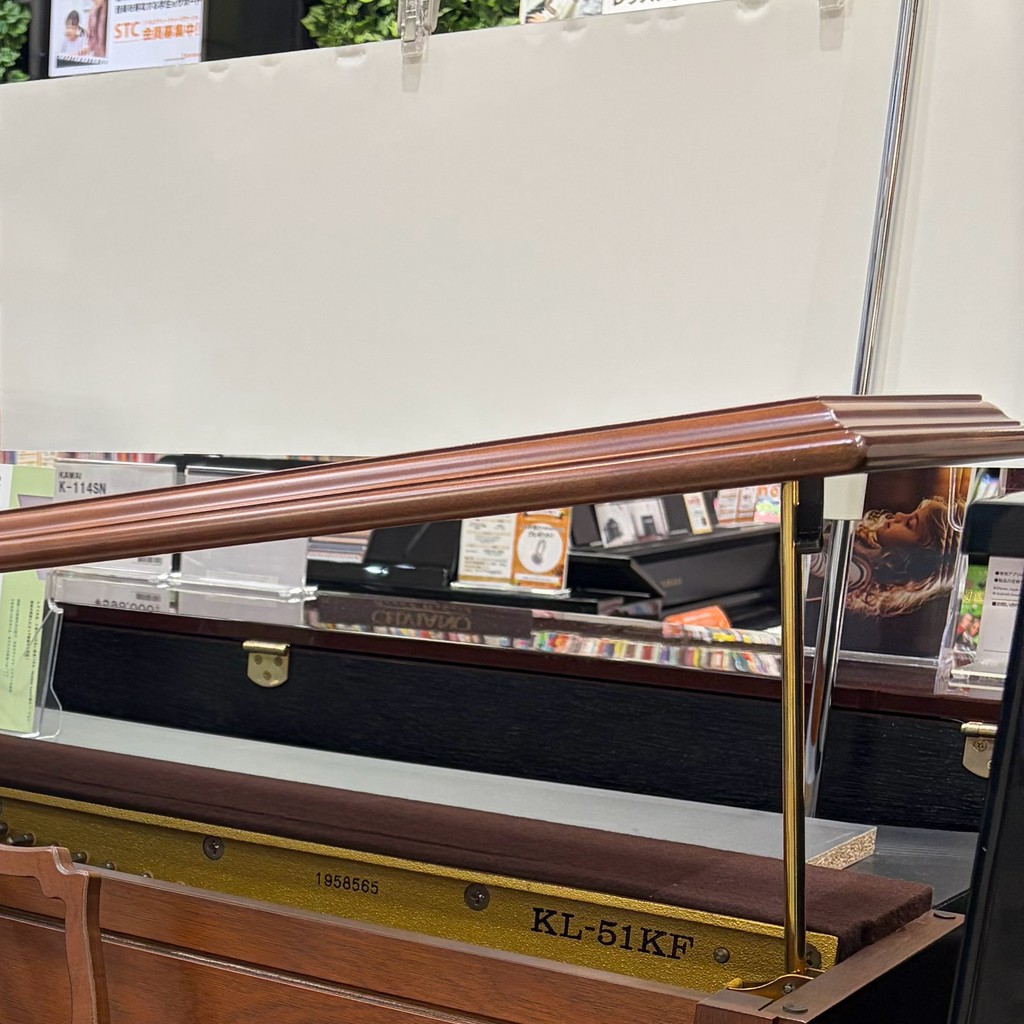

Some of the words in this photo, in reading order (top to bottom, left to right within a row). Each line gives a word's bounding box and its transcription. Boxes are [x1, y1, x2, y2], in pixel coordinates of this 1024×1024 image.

[58, 481, 107, 495] K-114SN
[315, 871, 379, 896] 1958565
[530, 907, 694, 960] KL-51KF
